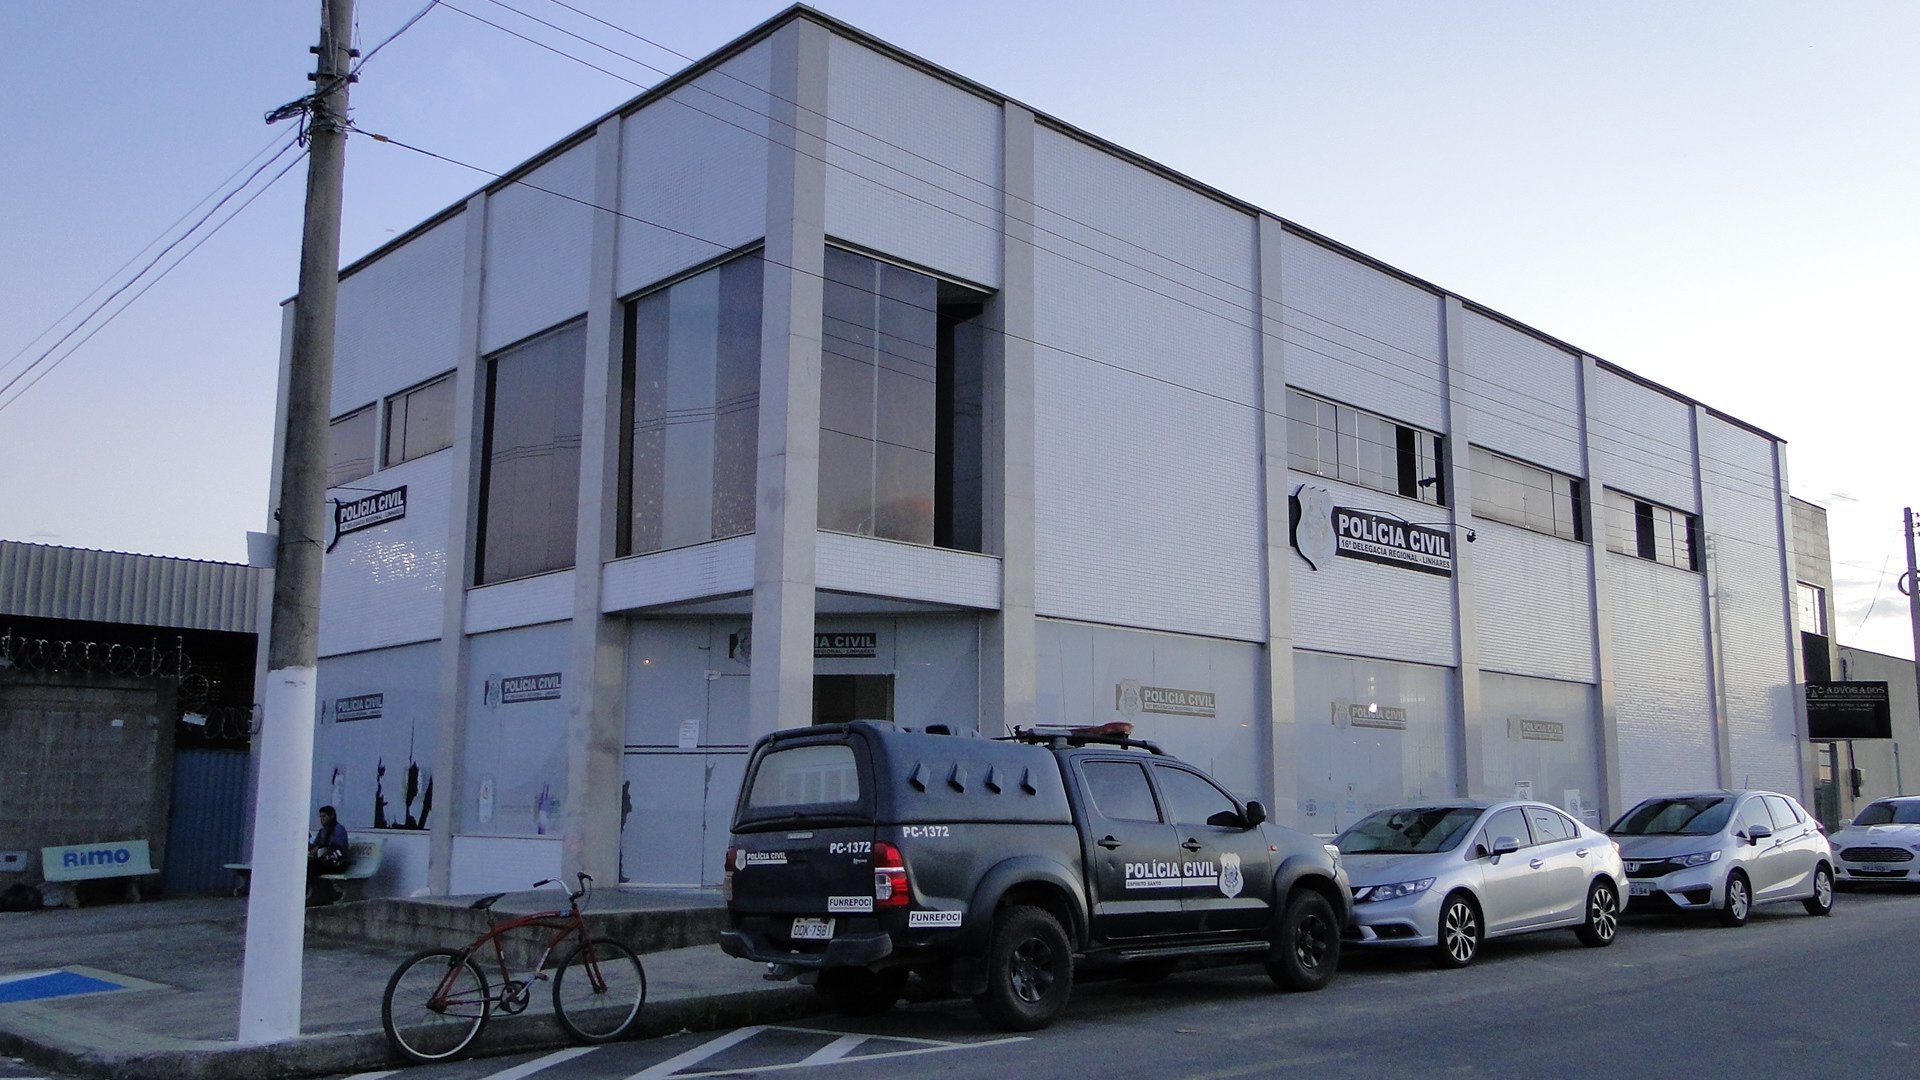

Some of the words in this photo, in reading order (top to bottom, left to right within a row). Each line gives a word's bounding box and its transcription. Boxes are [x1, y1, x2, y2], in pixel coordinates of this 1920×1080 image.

[341, 499, 376, 522] POLÍCIA
[378, 491, 403, 511] CIVIL
[1339, 514, 1406, 548] POLÍCIA
[1409, 530, 1450, 557] CIVIL
[1353, 542, 1387, 556] DELEGACIA
[1389, 549, 1418, 562] REGIONAL
[1422, 556, 1450, 568] LINHARES
[834, 636, 875, 647] CIVIL
[538, 675, 560, 689] CIVIL
[1827, 686, 1885, 694] ADVOGADOS
[1144, 688, 1185, 705] POLÍCIA
[1188, 693, 1215, 707] CIVIL
[1385, 709, 1405, 721] CIVIL
[902, 825, 950, 838] PC-1372
[830, 841, 871, 854] PC-1372
[63, 848, 131, 868] Rimo
[747, 851, 770, 860] POLÍCIA
[770, 851, 787, 860] CIVIL
[1125, 859, 1181, 878] POLÍCIA
[1183, 861, 1218, 877] CIVIL
[829, 898, 872, 907] FUNREPOCI
[911, 913, 961, 921] FUNREPOCI
